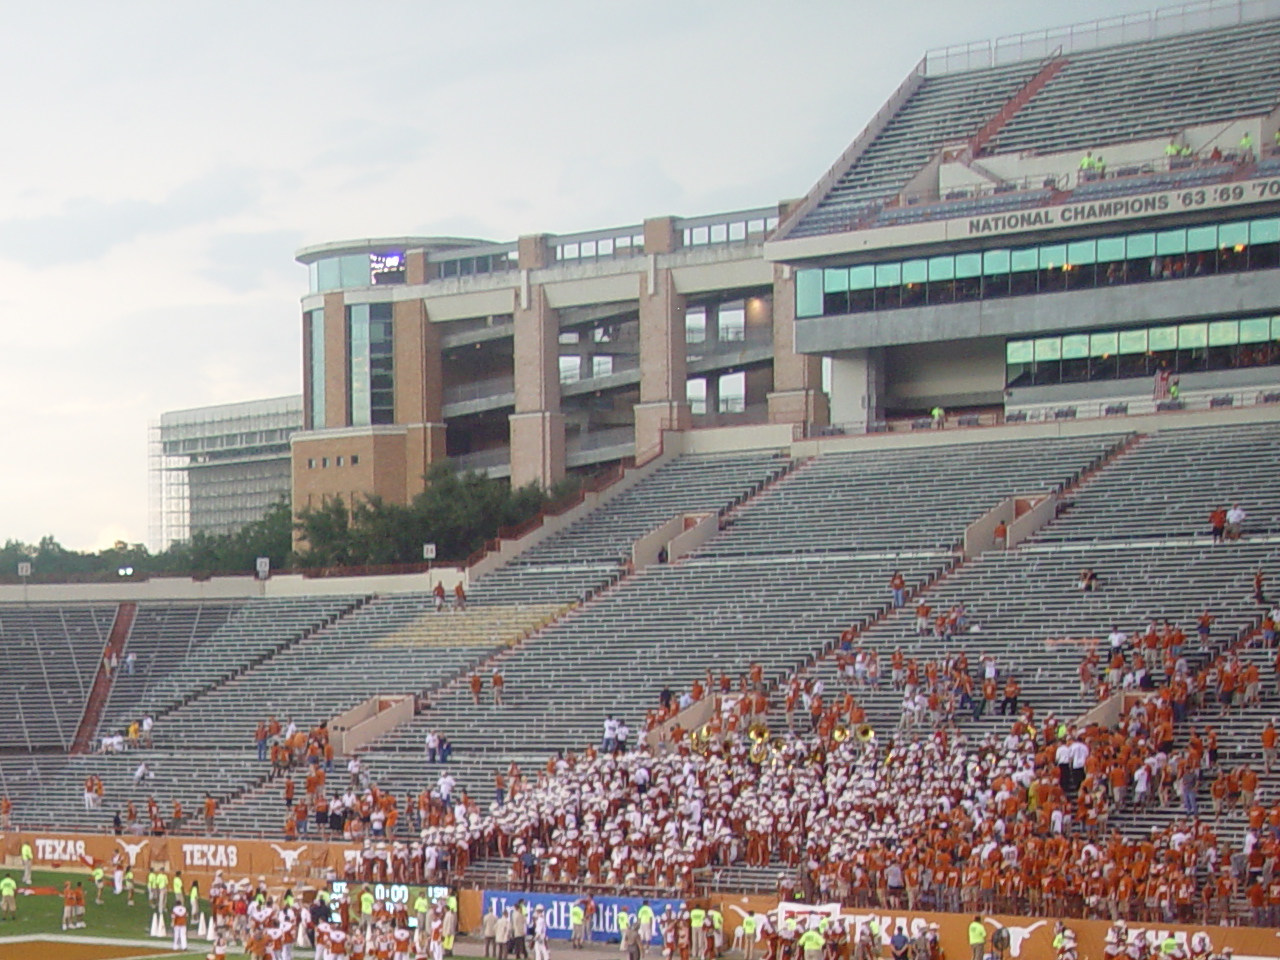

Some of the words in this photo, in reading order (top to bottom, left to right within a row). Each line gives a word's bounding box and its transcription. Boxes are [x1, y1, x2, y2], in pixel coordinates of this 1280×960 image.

[969, 210, 1054, 234] NATIONAL
[1060, 193, 1170, 221] CHAMPIONS
[1176, 189, 1206, 207] '63
[1212, 184, 1244, 203] '69
[35, 839, 86, 861] TEXAS
[182, 844, 238, 867] TEXAS
[490, 897, 662, 937] UntdHlthar
